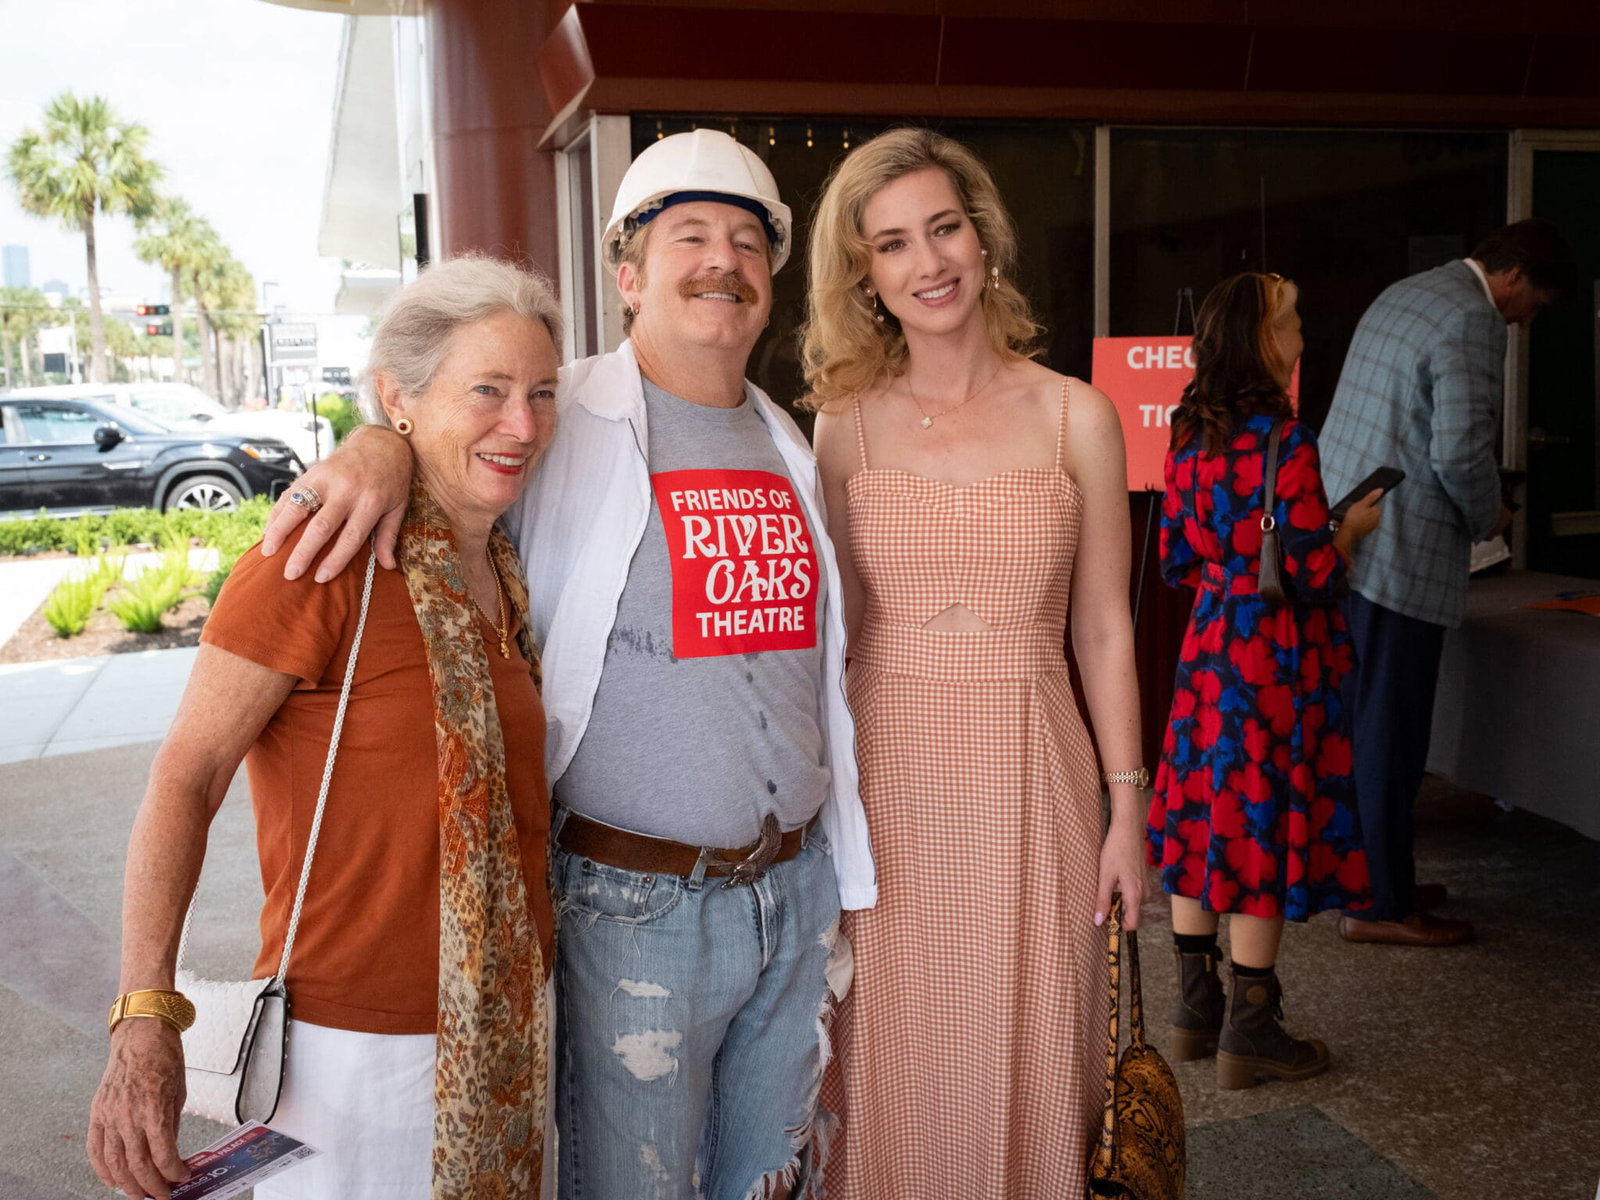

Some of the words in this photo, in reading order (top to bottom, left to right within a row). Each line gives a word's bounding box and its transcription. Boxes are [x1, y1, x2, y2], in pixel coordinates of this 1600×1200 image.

[1126, 346, 1198, 369] CHEC
[1138, 404, 1180, 428] TIC
[670, 488, 767, 512] FRIENDS
[769, 489, 792, 510] OF
[680, 514, 809, 559] RIVER
[705, 558, 811, 605] OAKS
[696, 606, 805, 638] THEATRE
[217, 1137, 247, 1158] PALACE
